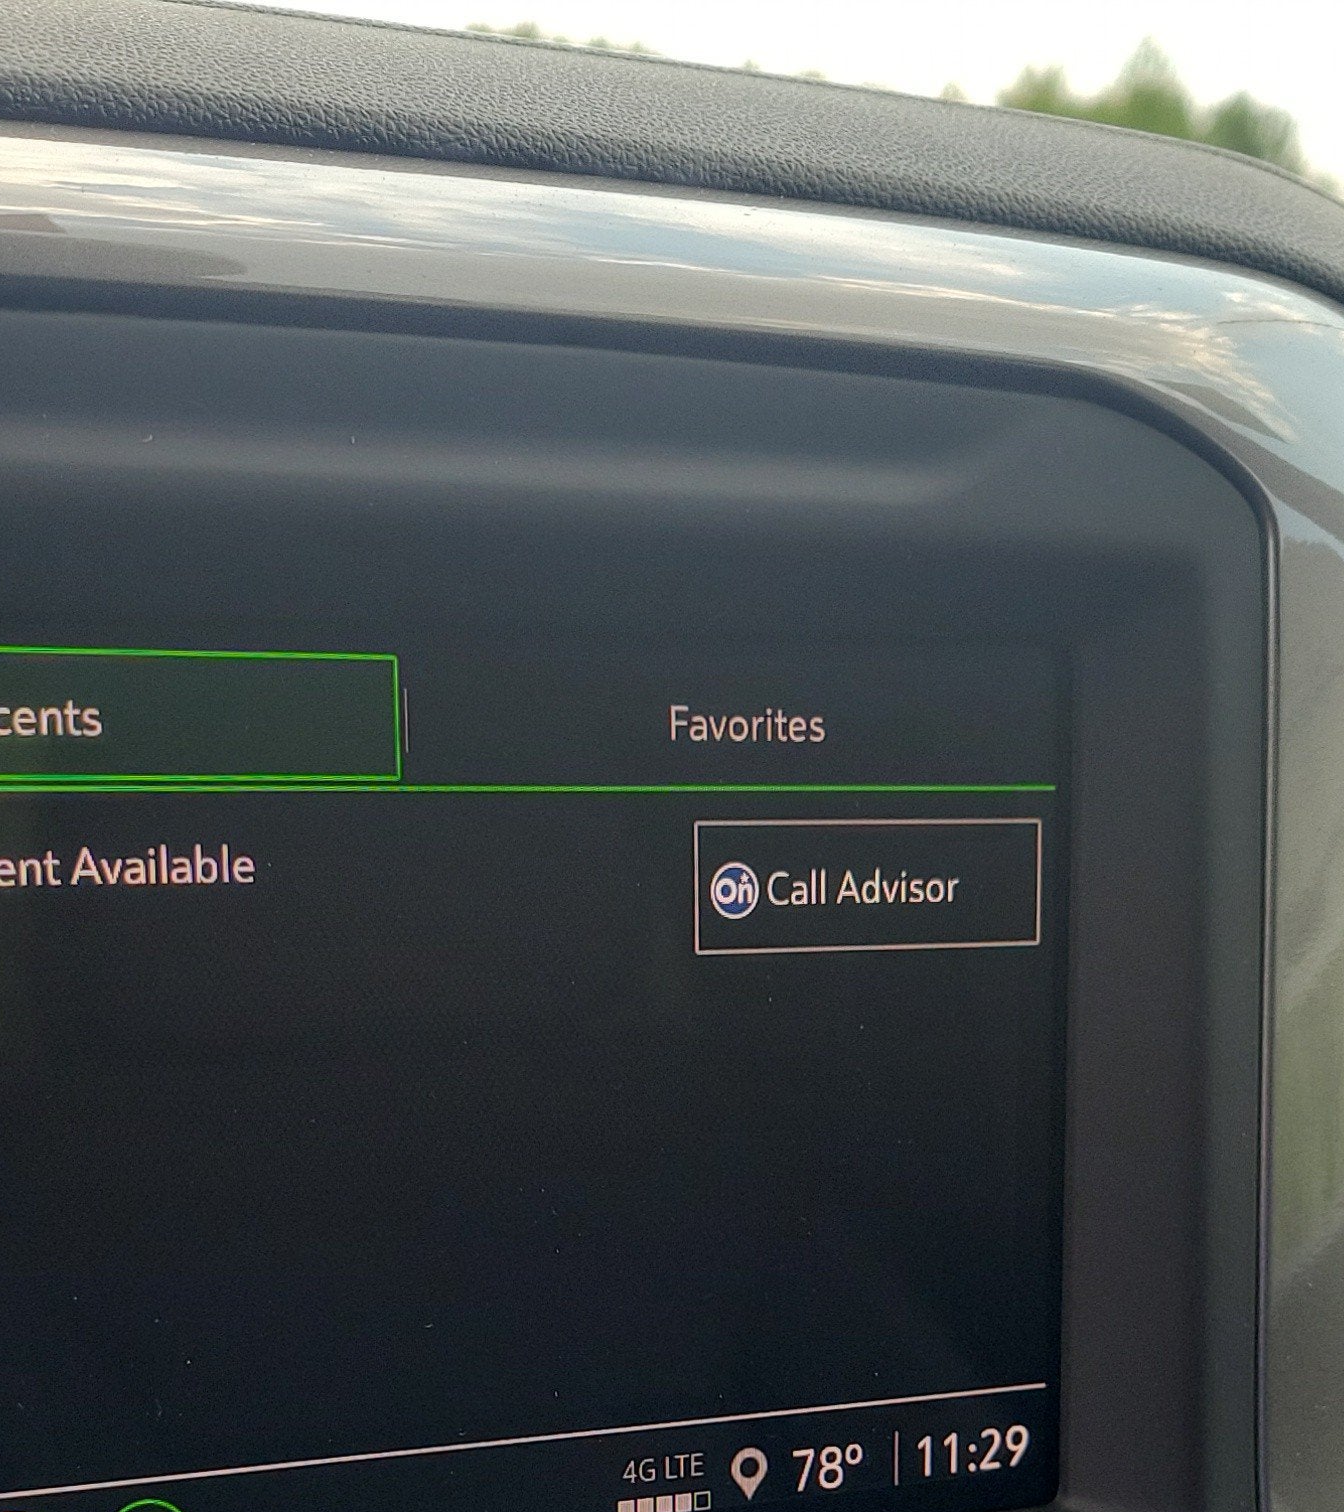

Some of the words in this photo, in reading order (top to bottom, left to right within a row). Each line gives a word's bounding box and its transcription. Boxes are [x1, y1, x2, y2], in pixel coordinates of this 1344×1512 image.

[668, 704, 827, 743] Favorites
[69, 842, 256, 887] Available
[715, 873, 754, 906] On
[766, 867, 827, 907] Call
[836, 866, 960, 905] Advisor
[622, 1457, 656, 1485] 4G
[664, 1452, 705, 1482] LTE
[791, 1442, 863, 1493] 78°
[916, 1423, 1031, 1478] 11:29
